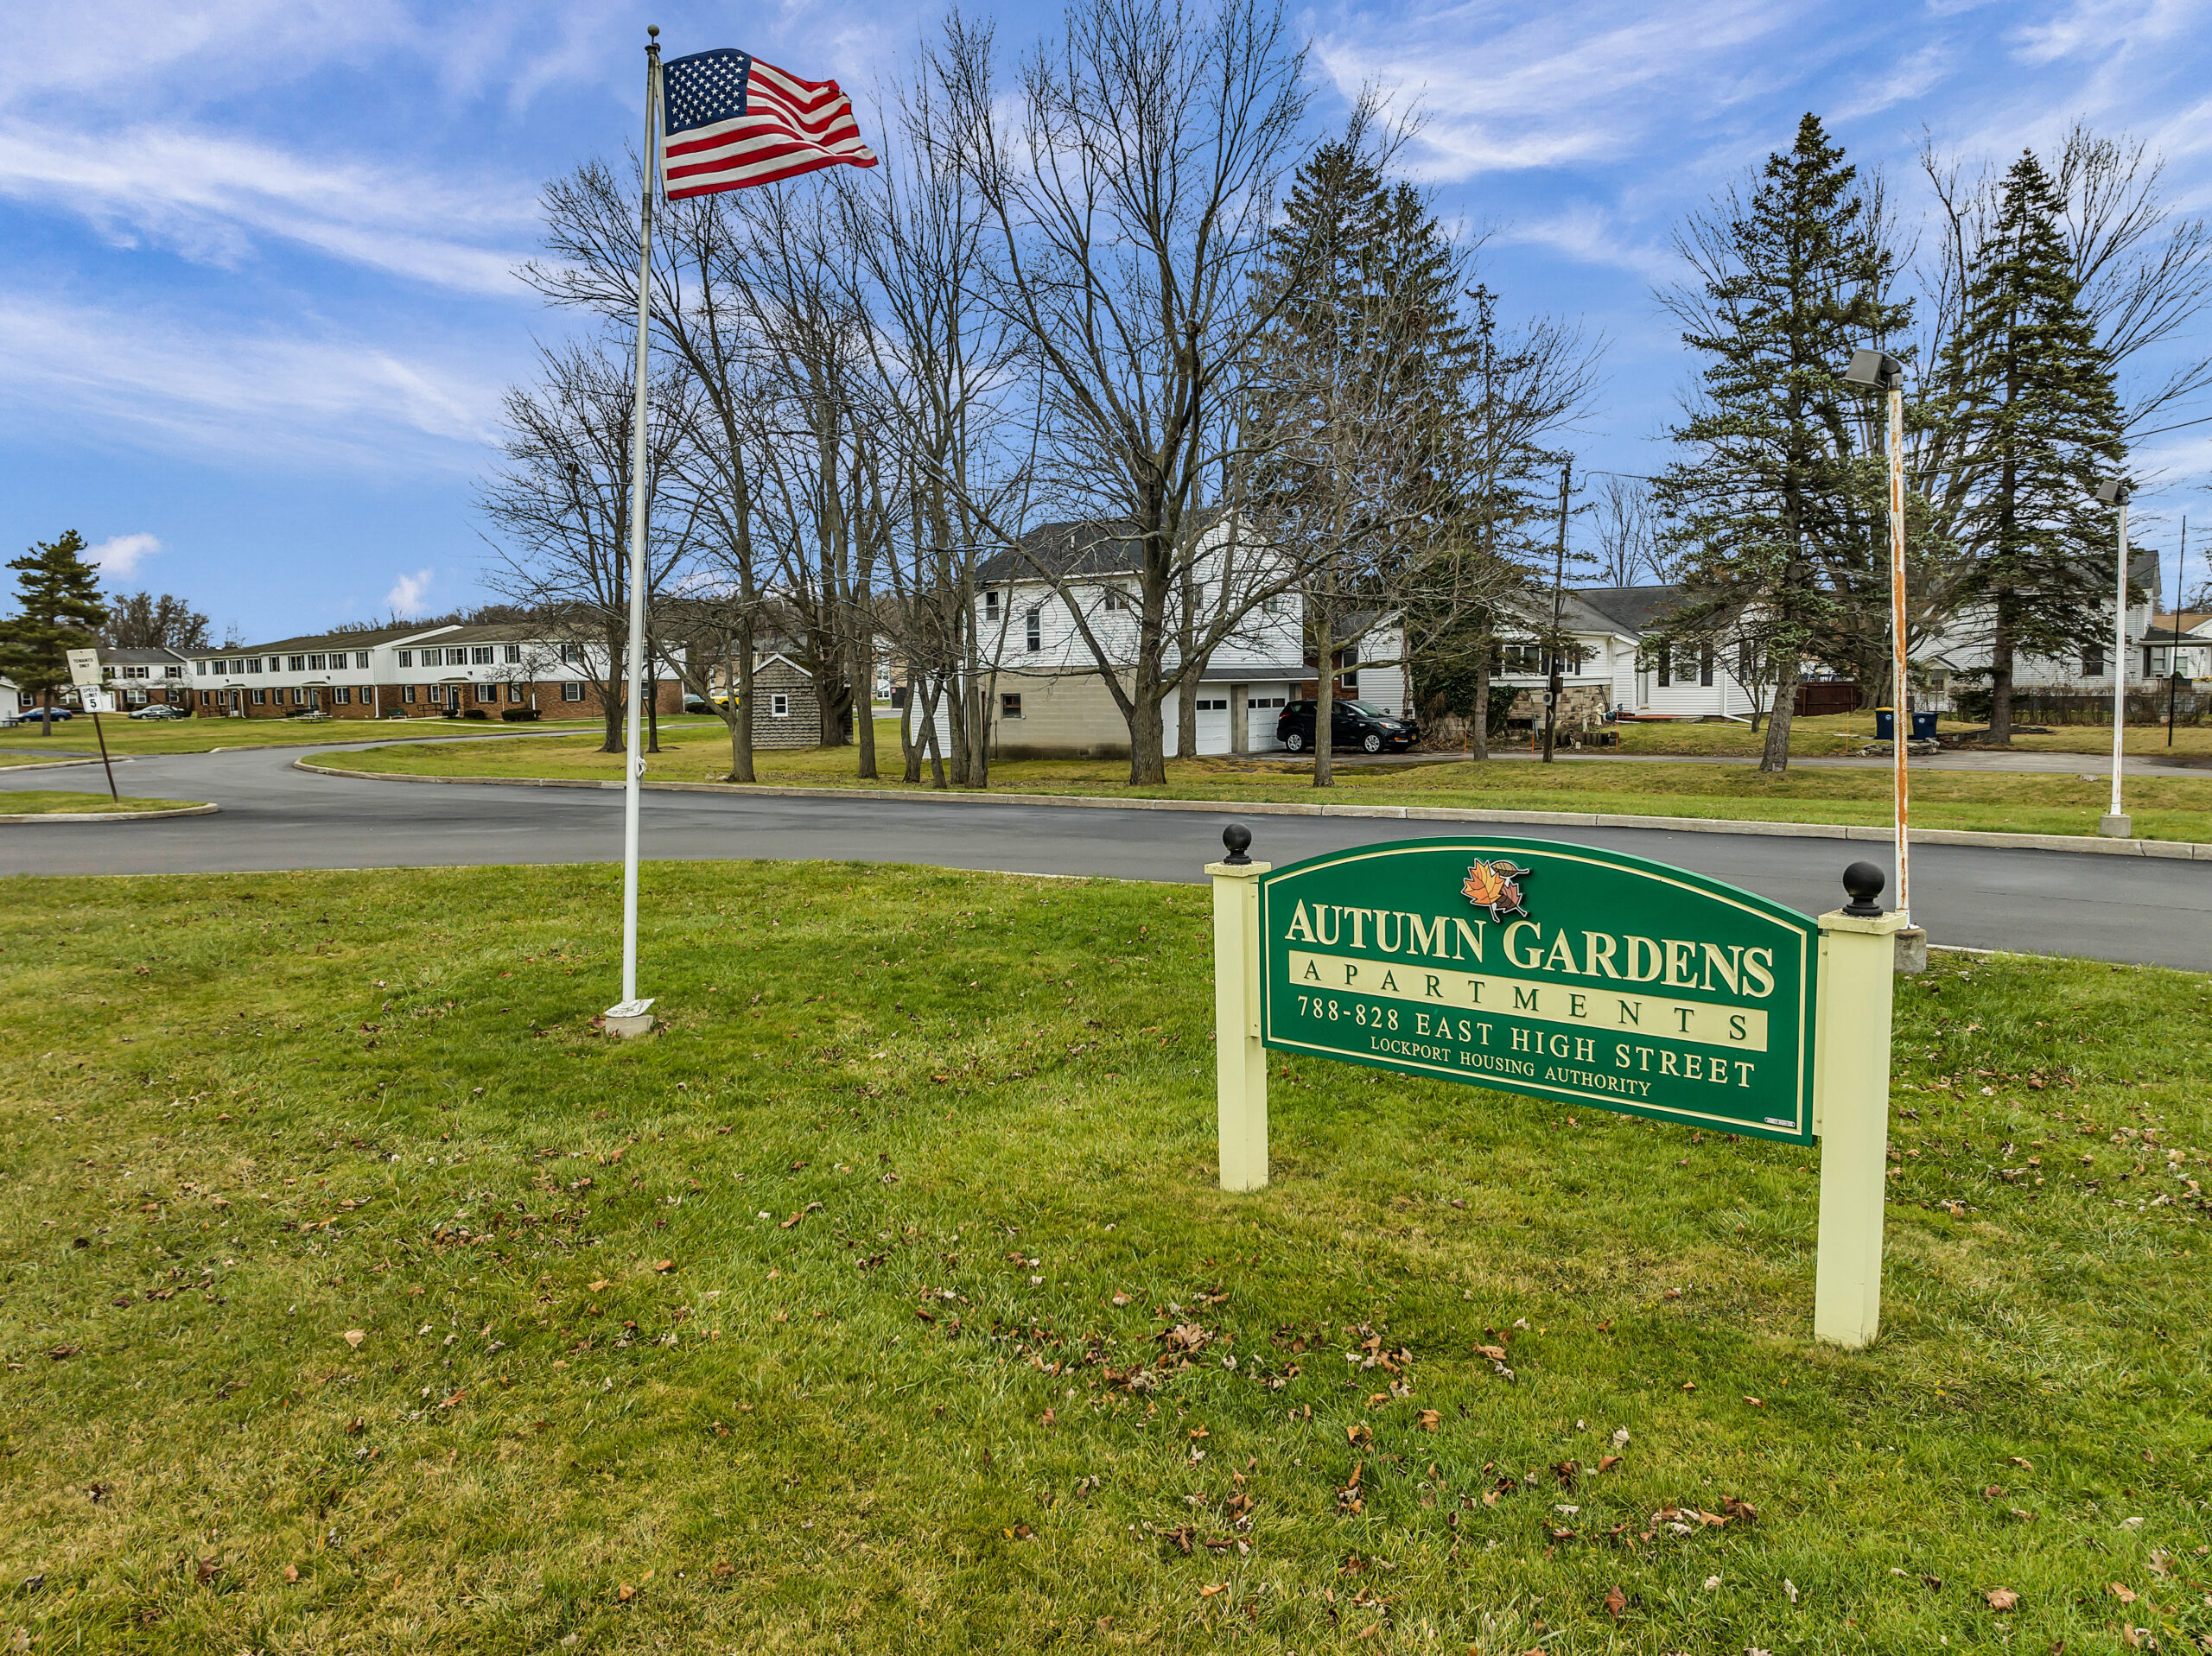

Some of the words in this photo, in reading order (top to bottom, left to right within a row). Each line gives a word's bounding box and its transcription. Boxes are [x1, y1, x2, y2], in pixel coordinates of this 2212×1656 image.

[90, 699, 97, 707] 5
[1285, 898, 1487, 963] AUTUMN
[1503, 920, 1776, 998] GARDENS
[1303, 959, 1747, 1041] APARTMENTS
[1297, 995, 1399, 1031] 788-828
[1415, 1012, 1493, 1046] EAST
[1510, 1027, 1596, 1063] HIGH
[1615, 1044, 1755, 1088] STREET
[1370, 1036, 1452, 1063] LOCKPORT
[1459, 1050, 1535, 1077] HOUSING
[1544, 1066, 1652, 1096] AUTHORITY
